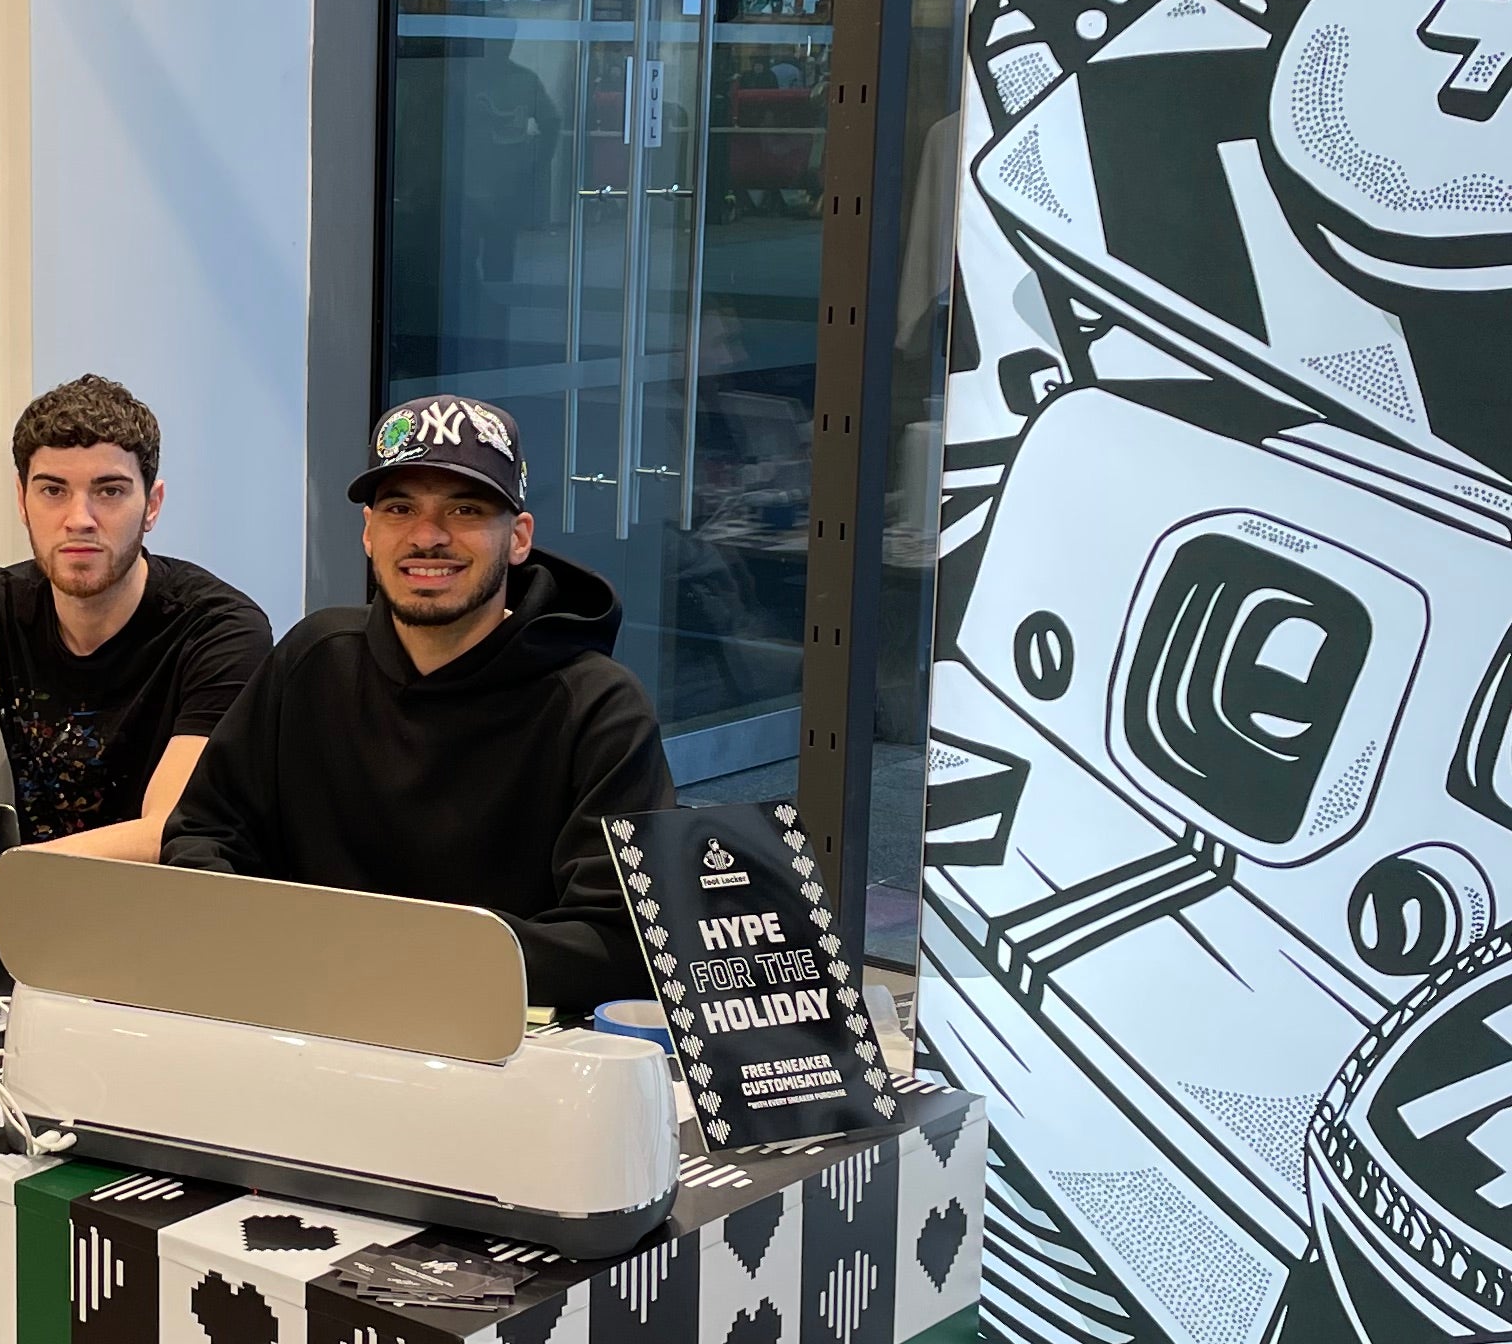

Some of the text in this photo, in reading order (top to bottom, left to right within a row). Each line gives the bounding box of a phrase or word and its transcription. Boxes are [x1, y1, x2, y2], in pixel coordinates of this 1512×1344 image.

[650, 69, 658, 139] PULL
[416, 401, 466, 445] NY
[698, 912, 786, 951] HYPE
[689, 948, 820, 994] FOR THE
[700, 988, 832, 1034] HOLIDAY
[741, 1055, 833, 1080] FREE SNEAKER
[741, 1069, 842, 1096] CUSTOMISATION
